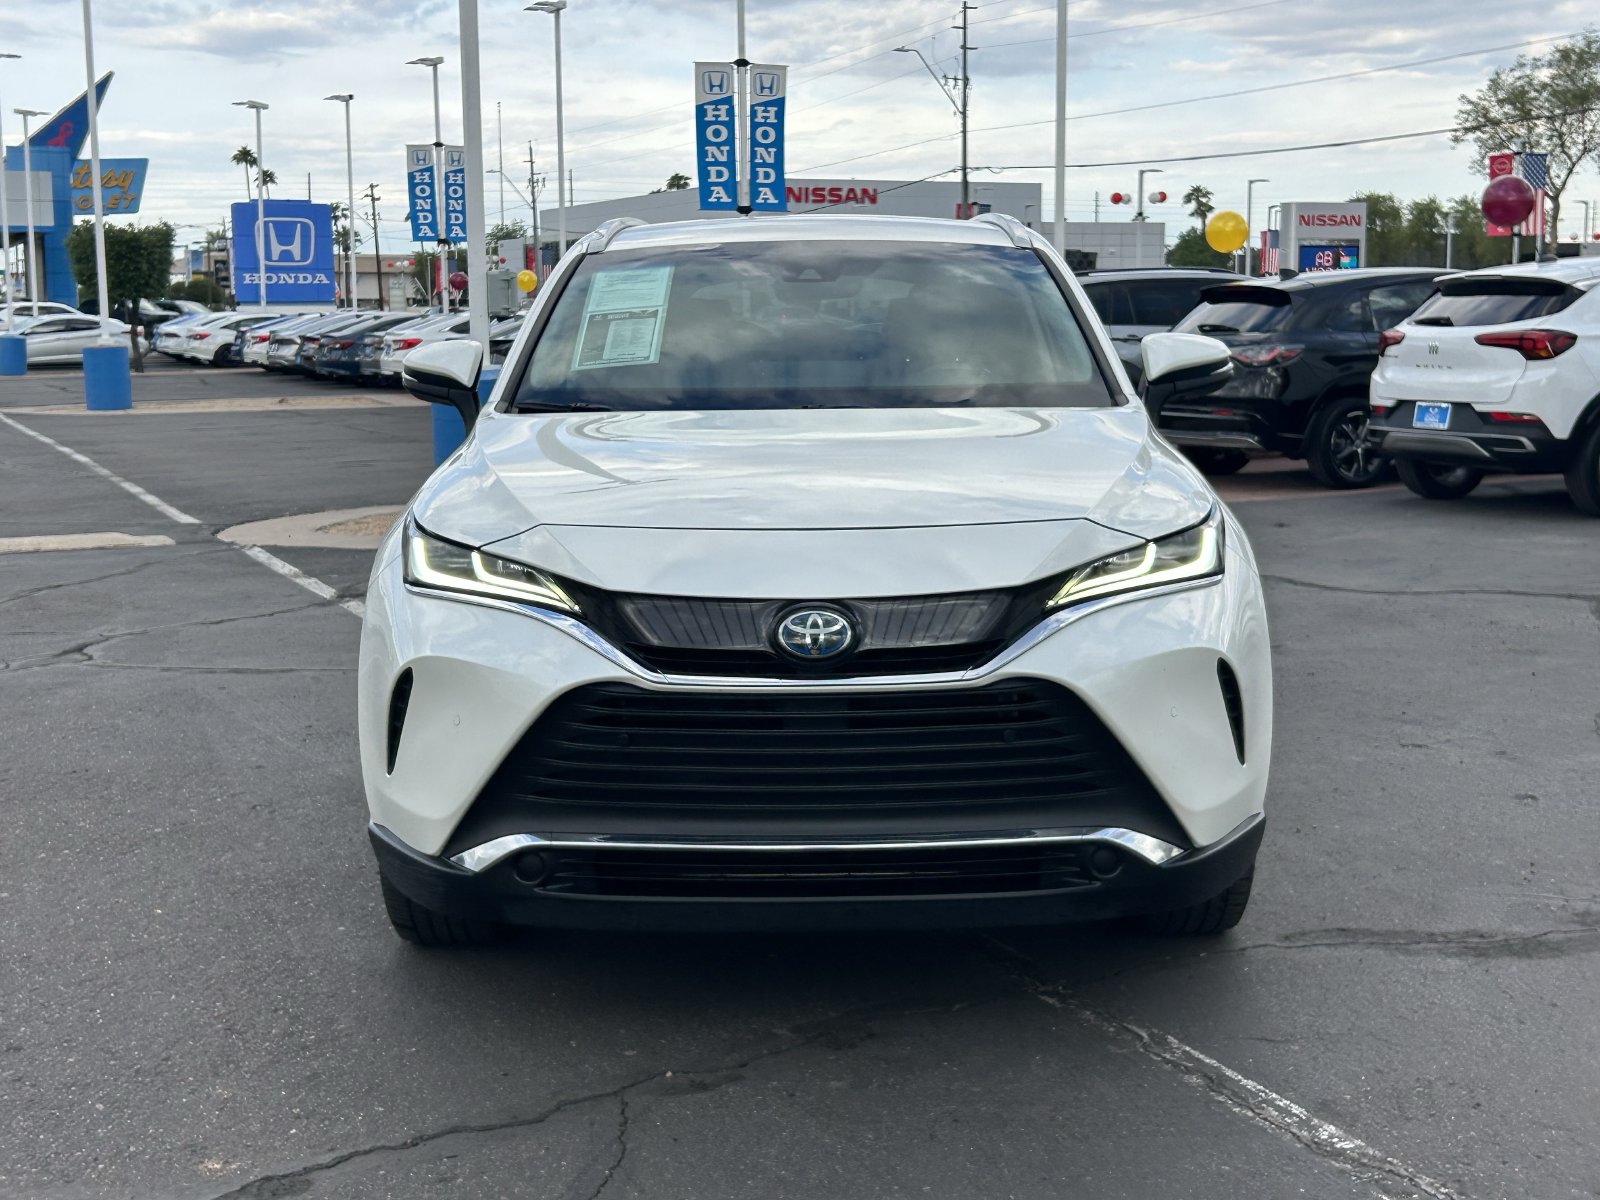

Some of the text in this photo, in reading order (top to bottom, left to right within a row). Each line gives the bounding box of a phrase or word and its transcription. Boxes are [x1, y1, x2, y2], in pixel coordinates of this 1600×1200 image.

[704, 105, 732, 202] HONDA
[754, 106, 778, 204] HONDA
[413, 171, 435, 236] HONDA
[447, 173, 466, 237] HONDA
[786, 186, 878, 205] NISSAN
[1298, 214, 1361, 227] NISSAN
[242, 272, 330, 285] HONDA
